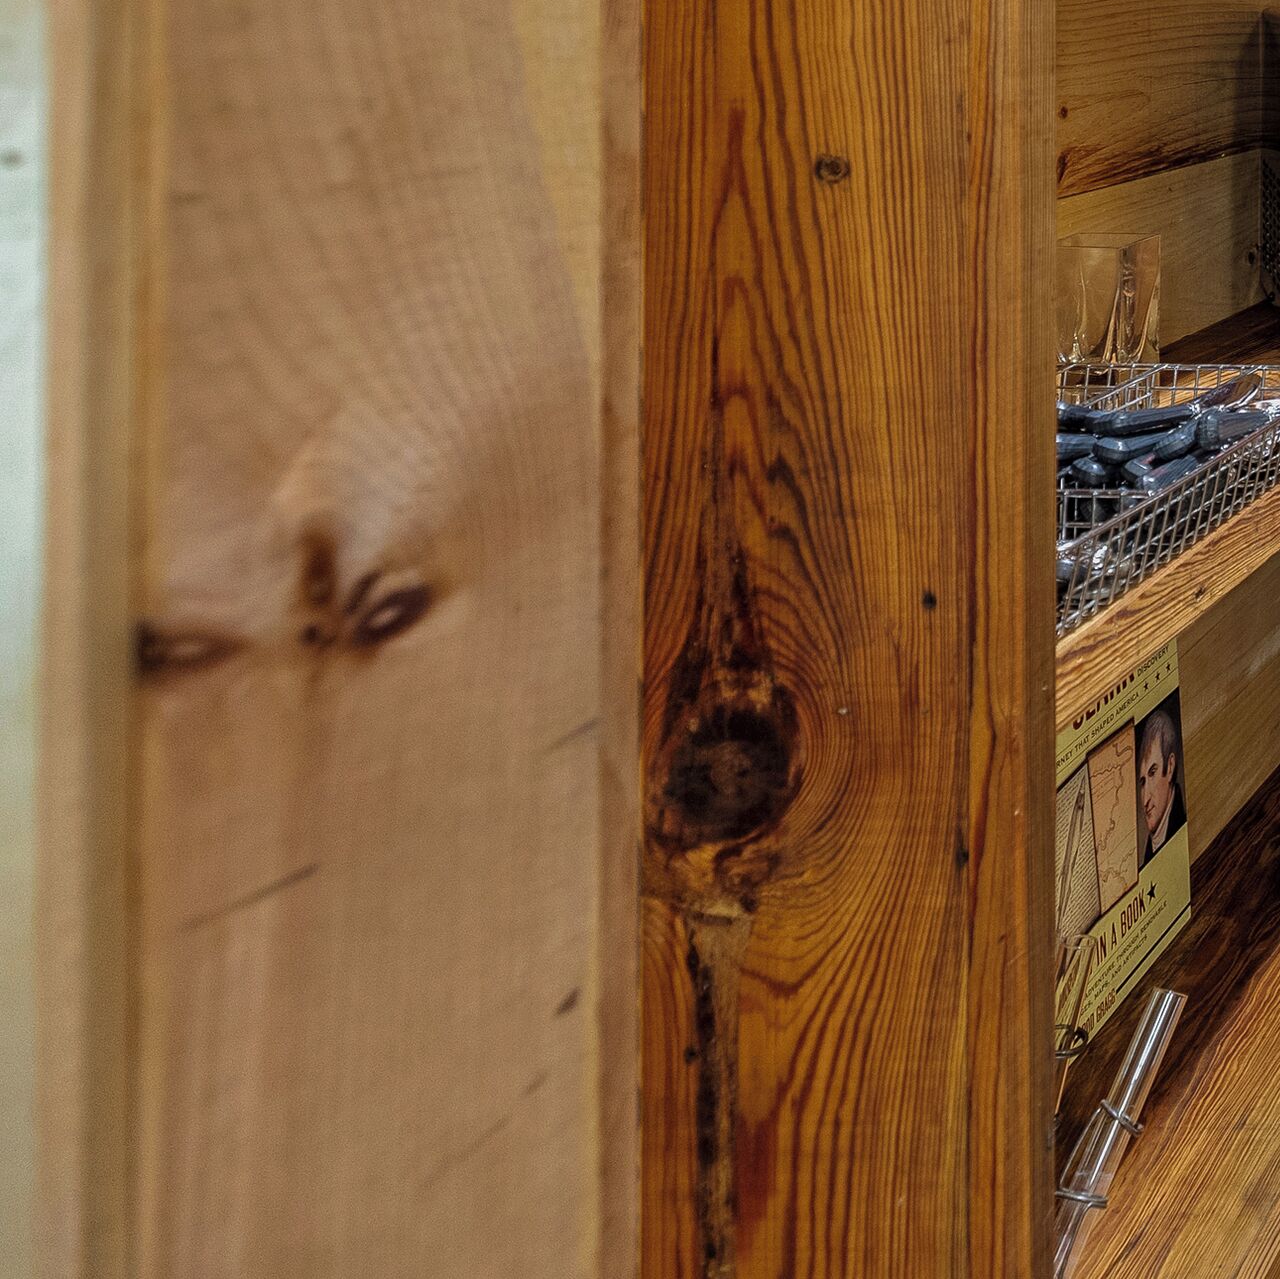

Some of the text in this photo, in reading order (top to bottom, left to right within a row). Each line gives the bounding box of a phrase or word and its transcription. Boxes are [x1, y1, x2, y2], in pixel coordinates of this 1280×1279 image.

[1136, 643, 1170, 677] DISCOVERY
[1056, 691, 1140, 768] RNEY THAT SHAPED AMERICA
[1095, 888, 1146, 965] IN A BOOK
